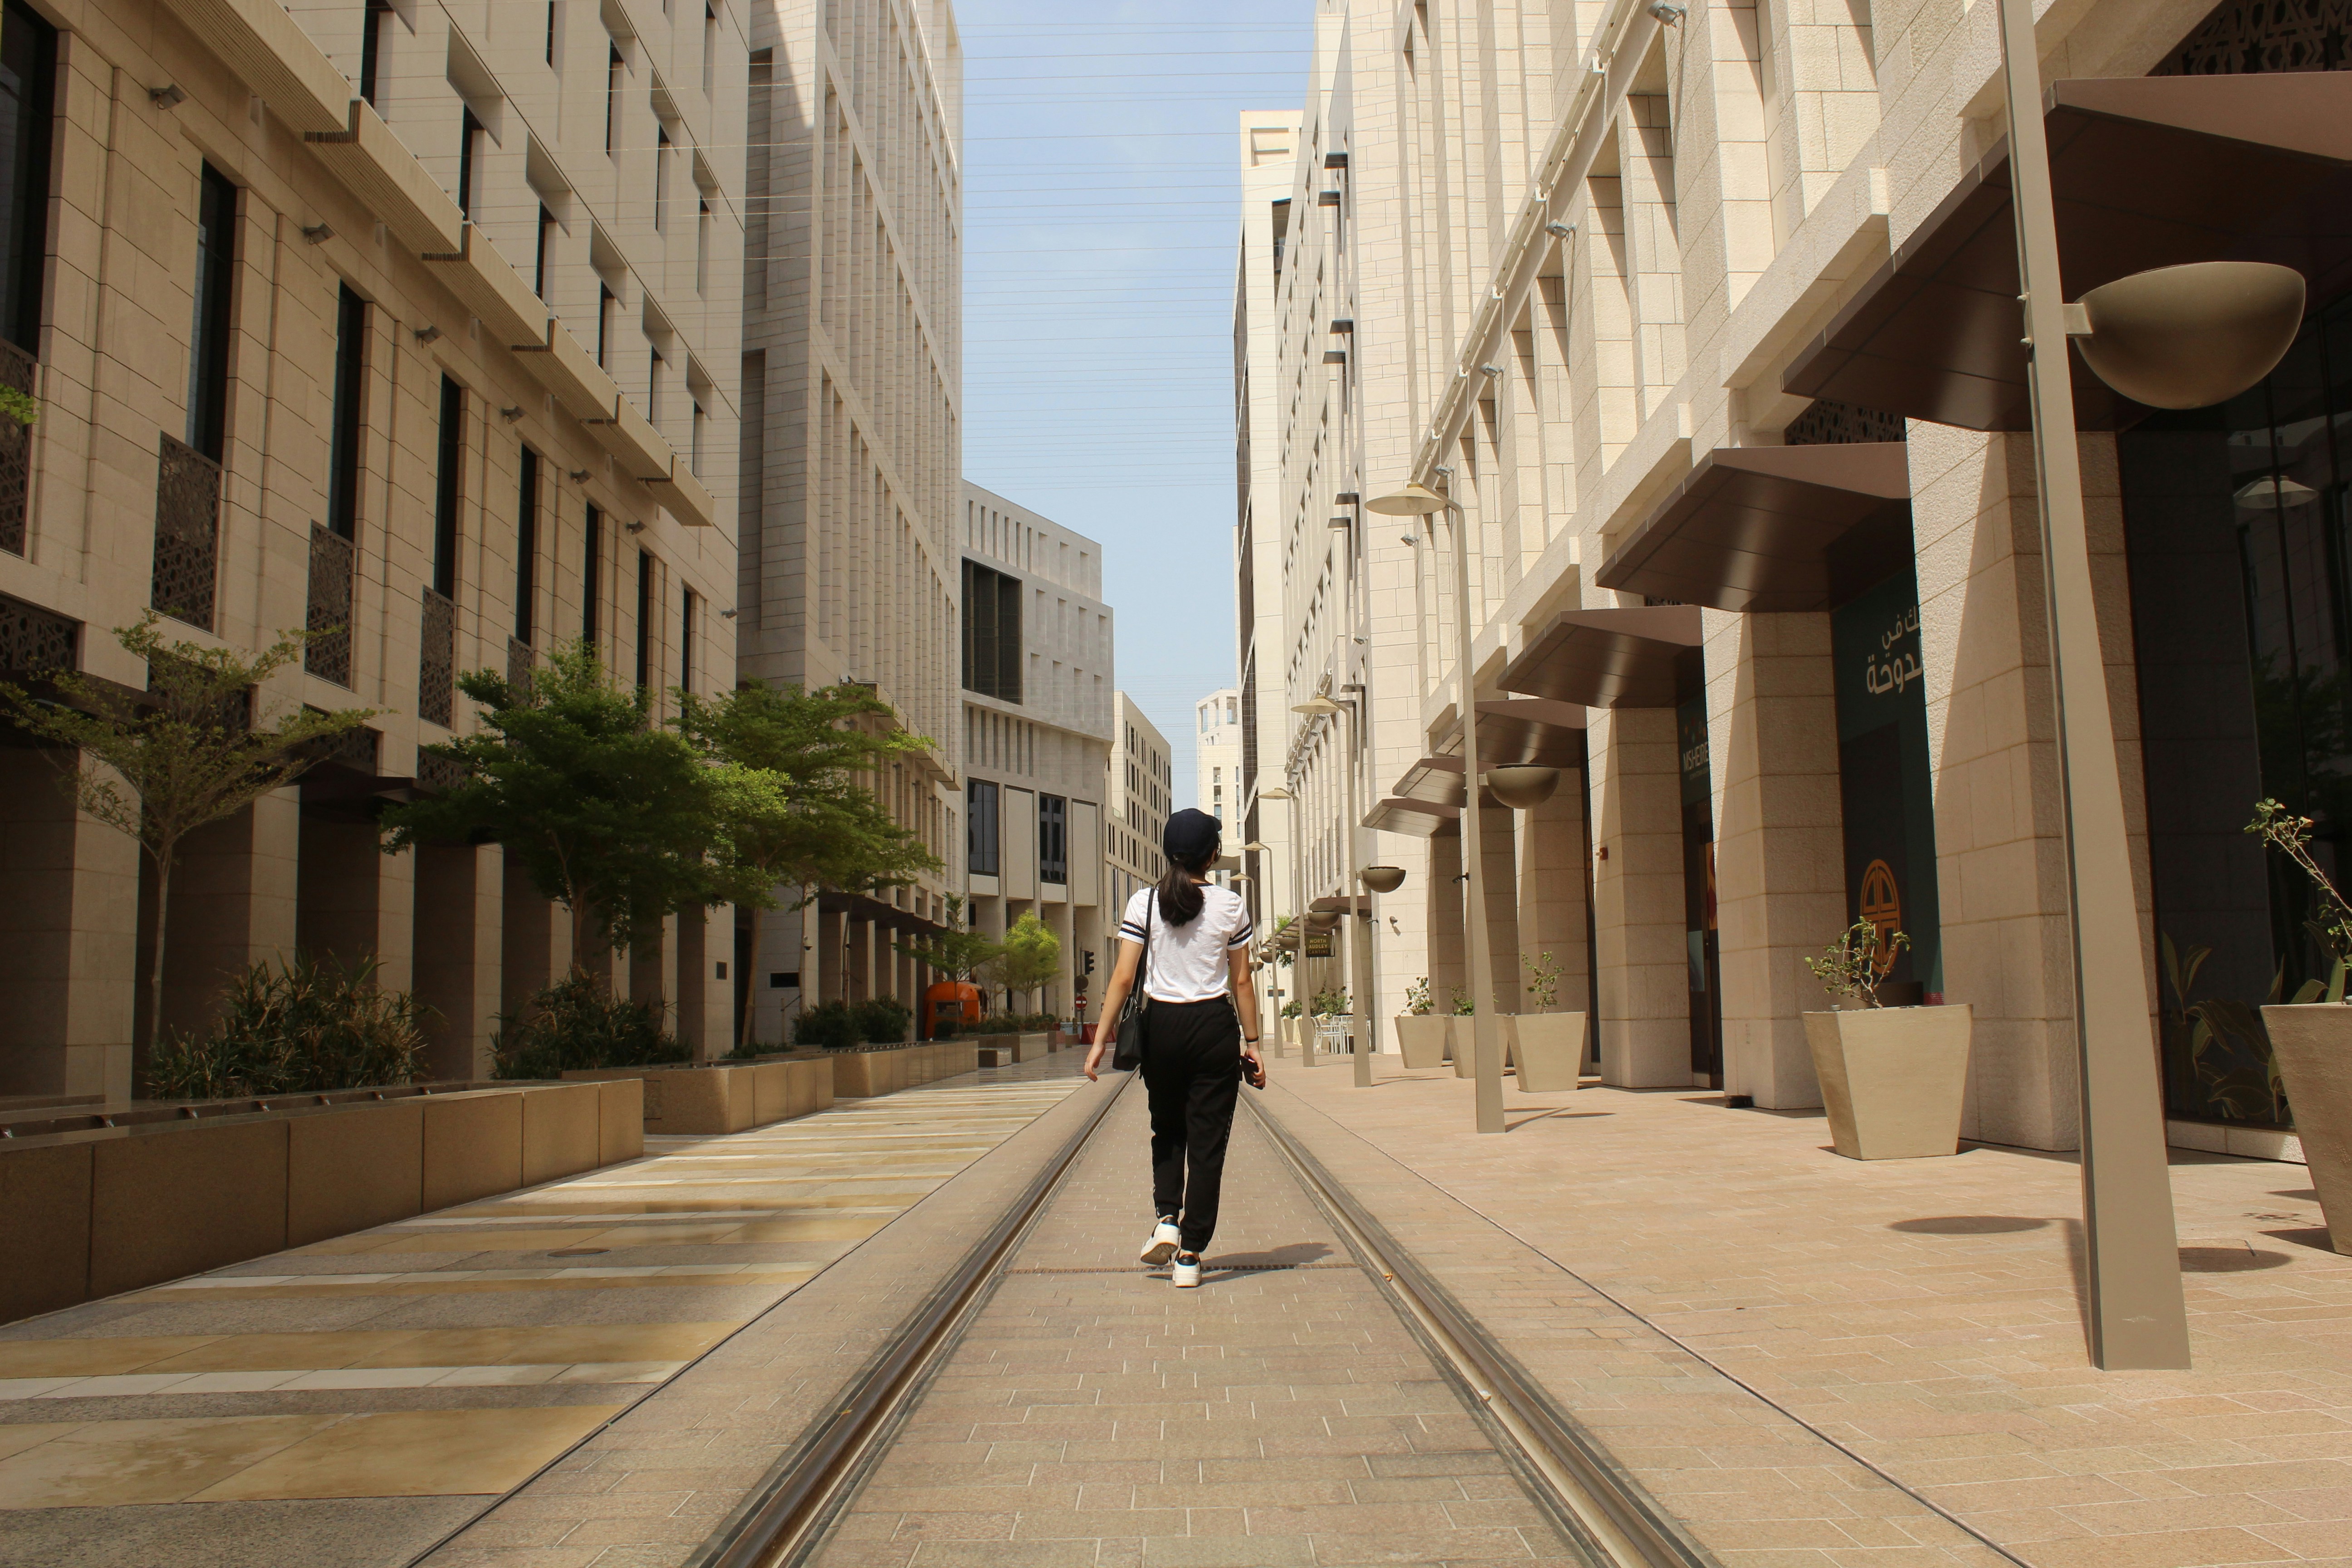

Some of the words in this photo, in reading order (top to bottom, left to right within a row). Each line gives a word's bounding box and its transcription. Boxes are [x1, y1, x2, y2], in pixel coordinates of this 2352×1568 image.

[1882, 614, 1903, 658] في
[1867, 636, 1922, 694] لدوحة
[1683, 741, 1709, 771] MSHEIRE
